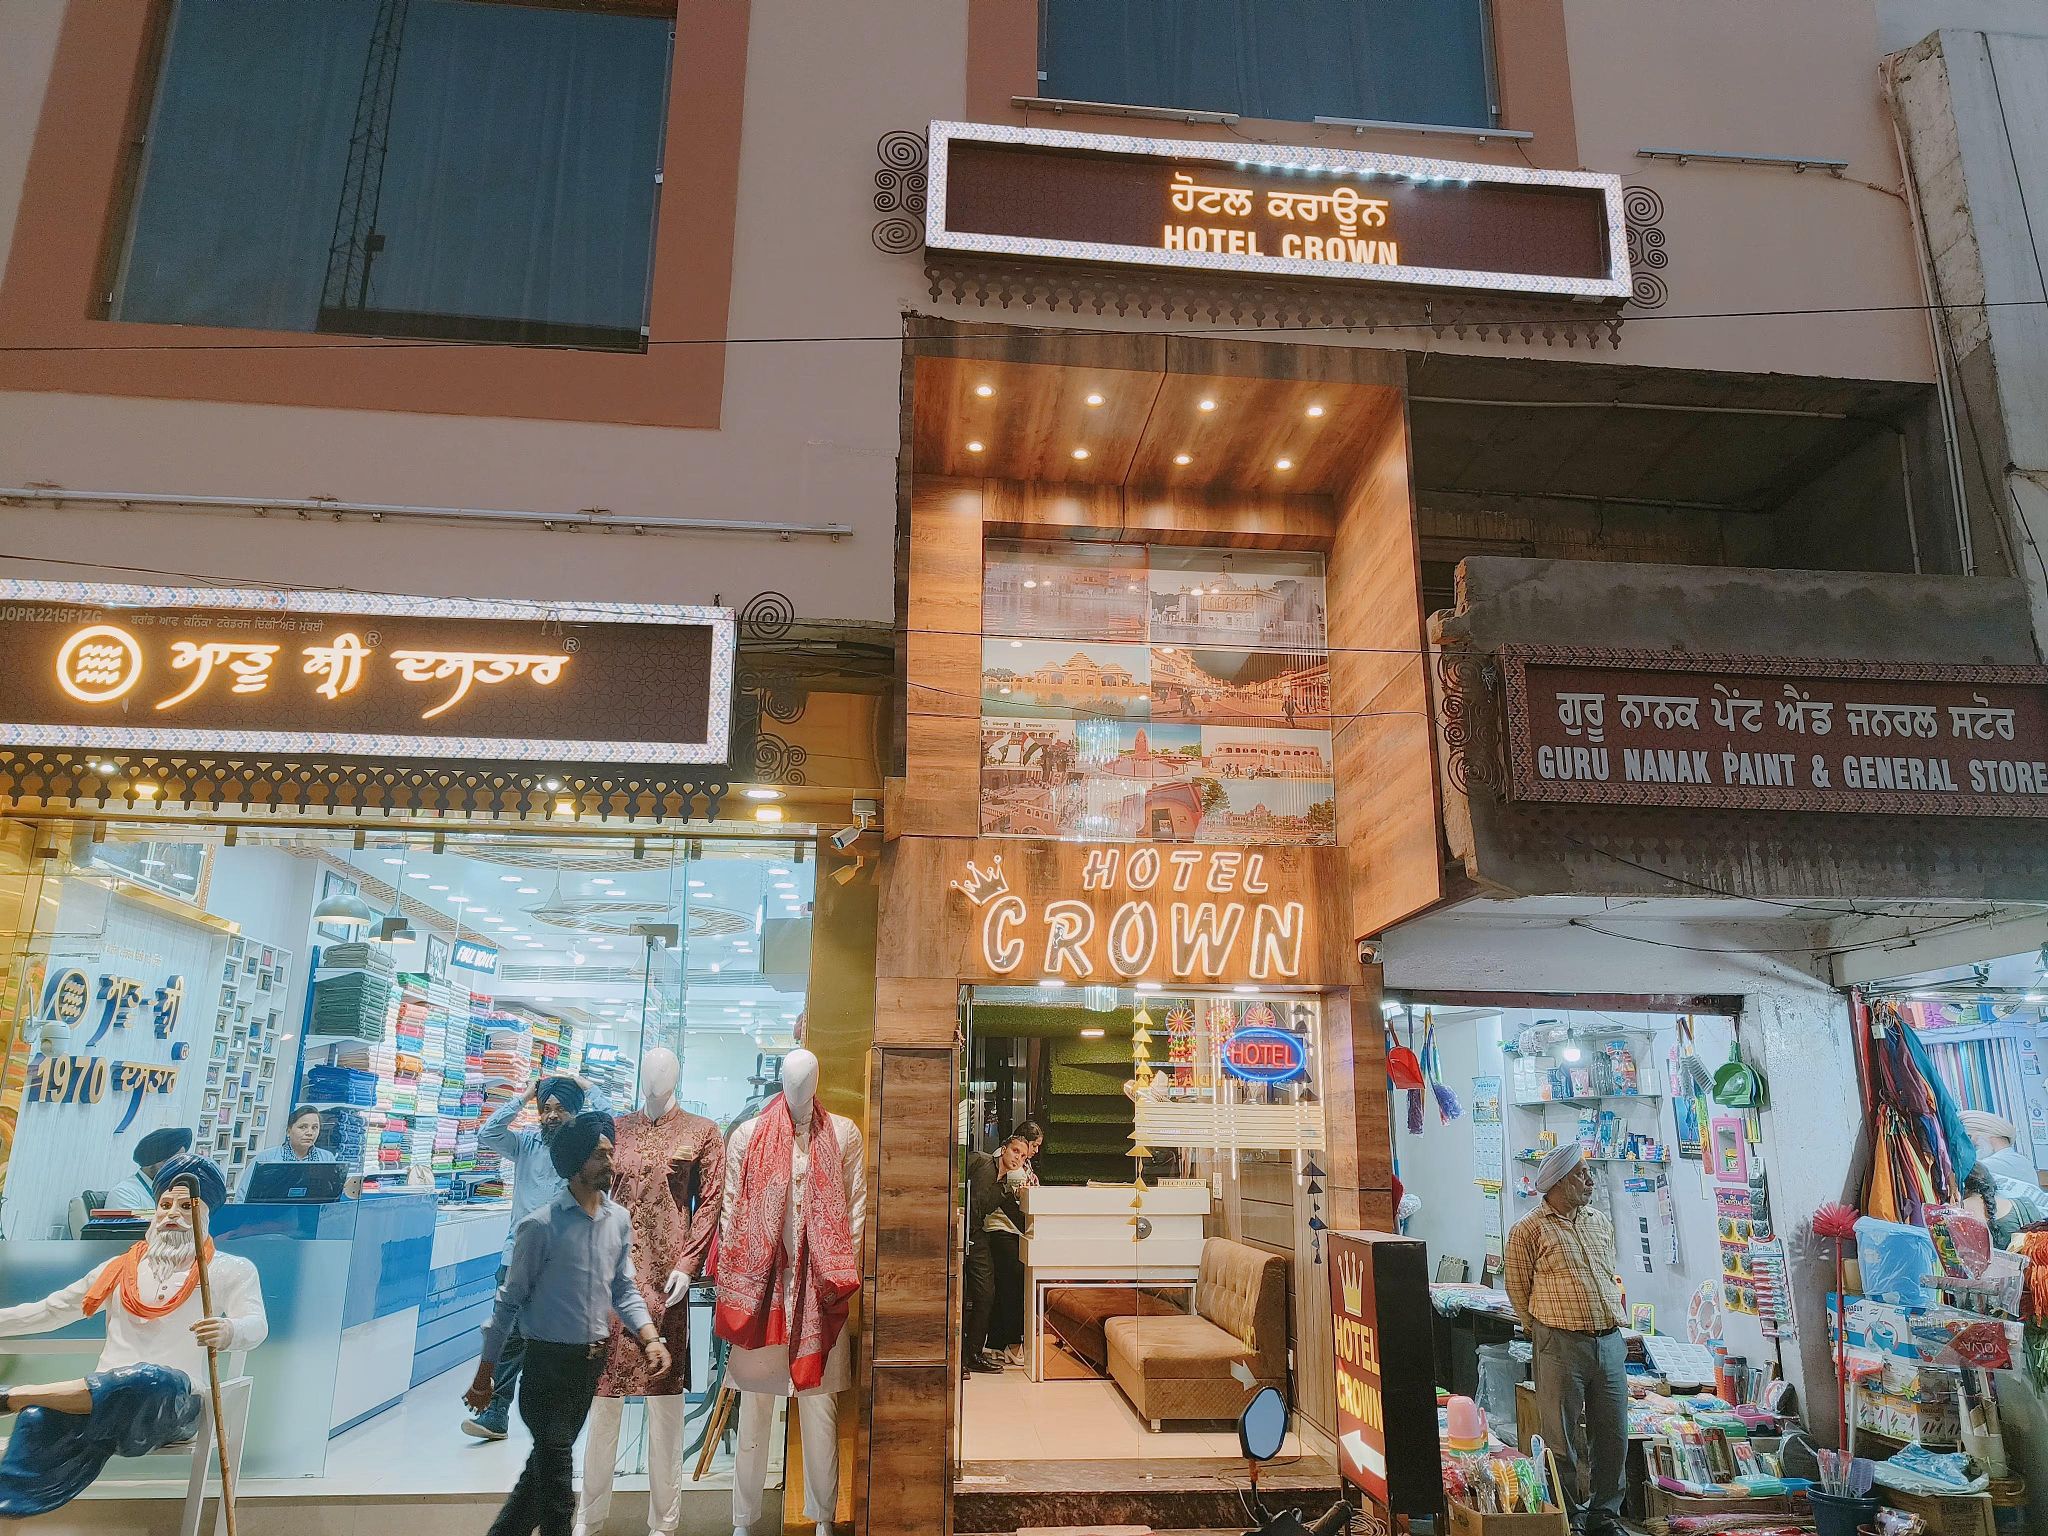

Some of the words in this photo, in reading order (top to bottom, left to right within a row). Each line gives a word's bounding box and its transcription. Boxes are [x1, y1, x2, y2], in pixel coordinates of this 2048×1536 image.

[1170, 171, 1253, 216] ਹੋਟਲ
[1267, 187, 1389, 237] ਕਰਾਊਨ
[1164, 225, 1264, 257] HOTEL
[1282, 234, 1398, 266] CROWN
[1555, 692, 1605, 742] ਗੁਰੂ
[1617, 694, 1700, 730] ਨਾਨਕ
[1846, 702, 1937, 739] ਜਨਰਲ
[1948, 692, 2015, 741] ਸਟੋਰ
[1537, 745, 1610, 781] GURU
[1623, 748, 1712, 784] NANAK
[1722, 751, 1796, 787] PAINT
[1811, 754, 1832, 788] &
[1842, 755, 1959, 792] GENERAL
[1968, 759, 2048, 794] STORE
[1083, 848, 1269, 894] HOTEL
[982, 895, 1304, 979] CROWN
[32, 1053, 107, 1105] 1970
[1231, 1043, 1297, 1067] HOTEL
[1333, 1313, 1380, 1376] HOTEL
[1337, 1369, 1383, 1433] CROWN
